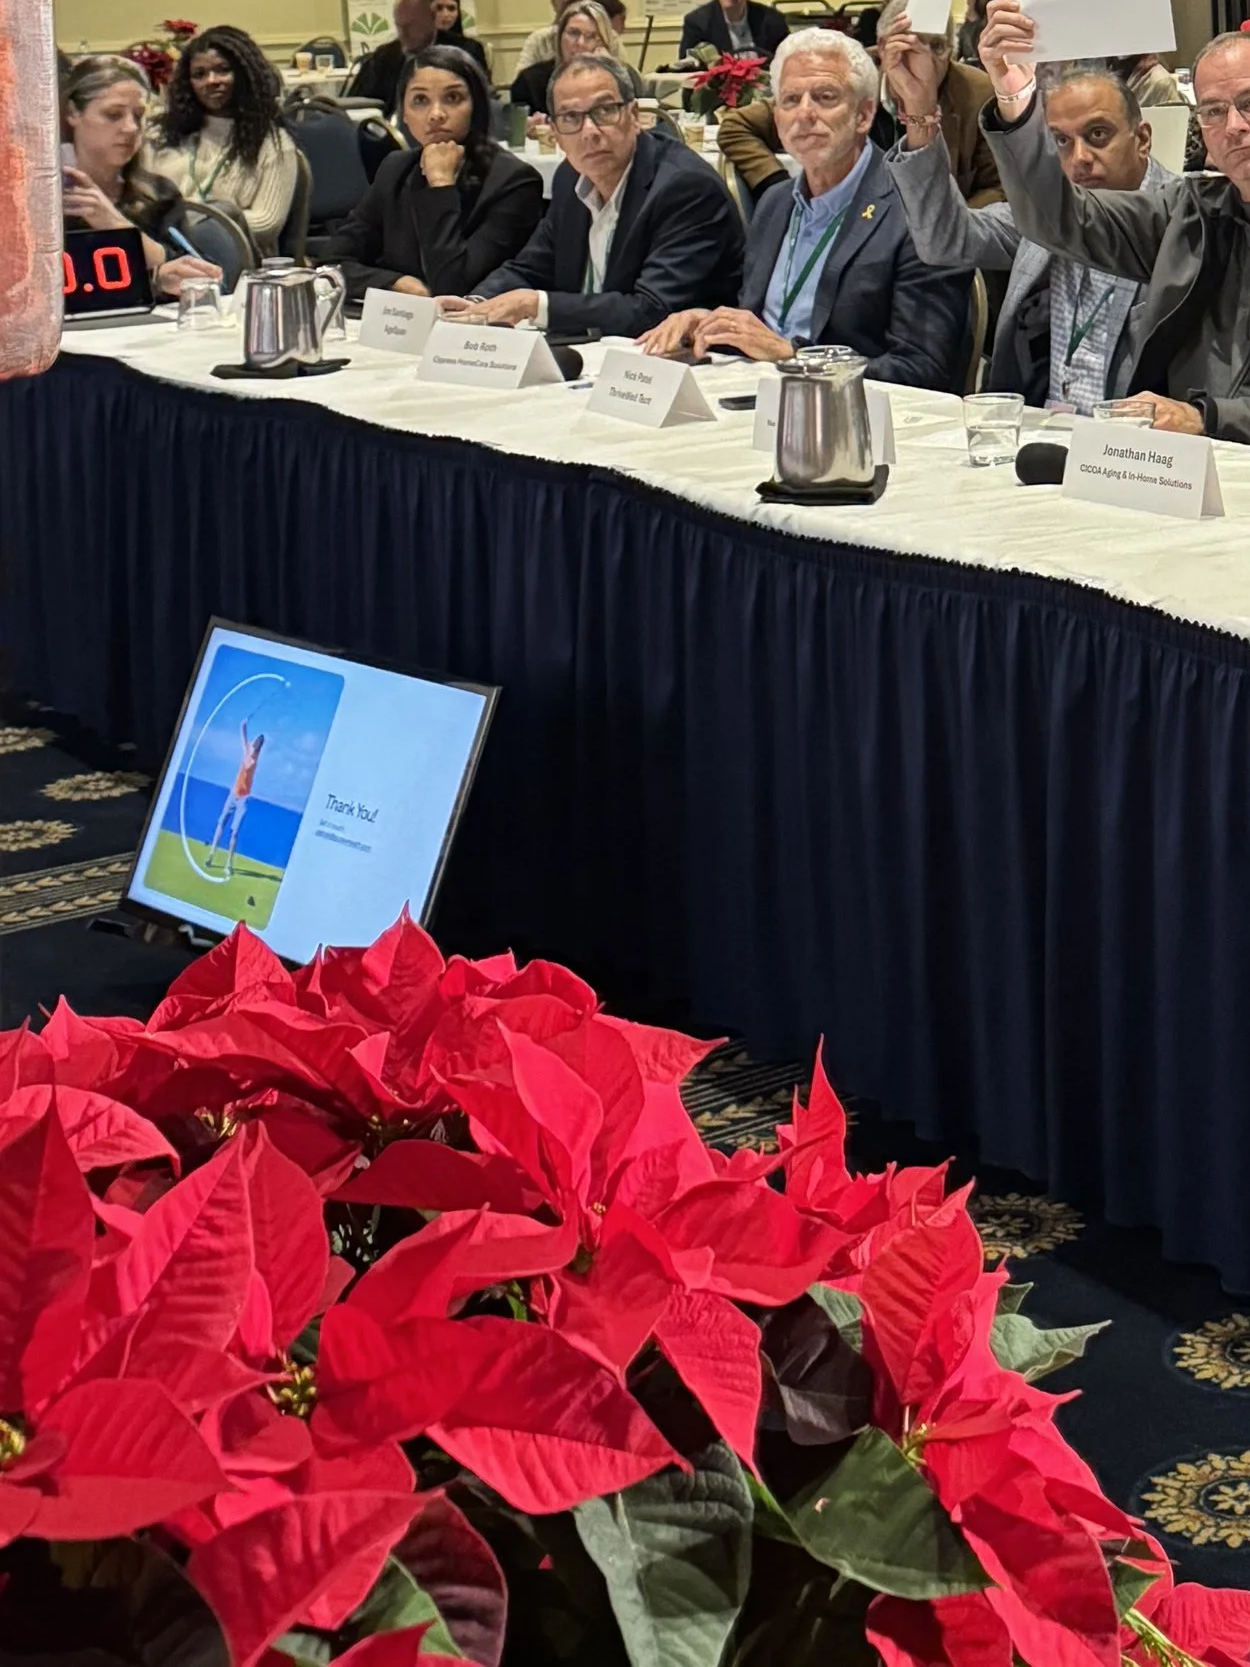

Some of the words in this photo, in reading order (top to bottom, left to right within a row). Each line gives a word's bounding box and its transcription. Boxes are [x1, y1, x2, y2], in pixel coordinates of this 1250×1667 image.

[464, 341, 479, 350] Bob
[1103, 444, 1146, 462] Jonathan
[1148, 452, 1173, 468] Haag
[1080, 464, 1101, 475] CICOA
[1102, 468, 1122, 480] Aging
[1122, 471, 1127, 479] &
[1128, 472, 1157, 485] In-Home
[1159, 477, 1192, 490] Solutions
[326, 794, 355, 816] Thank
[356, 803, 379, 823] You!
